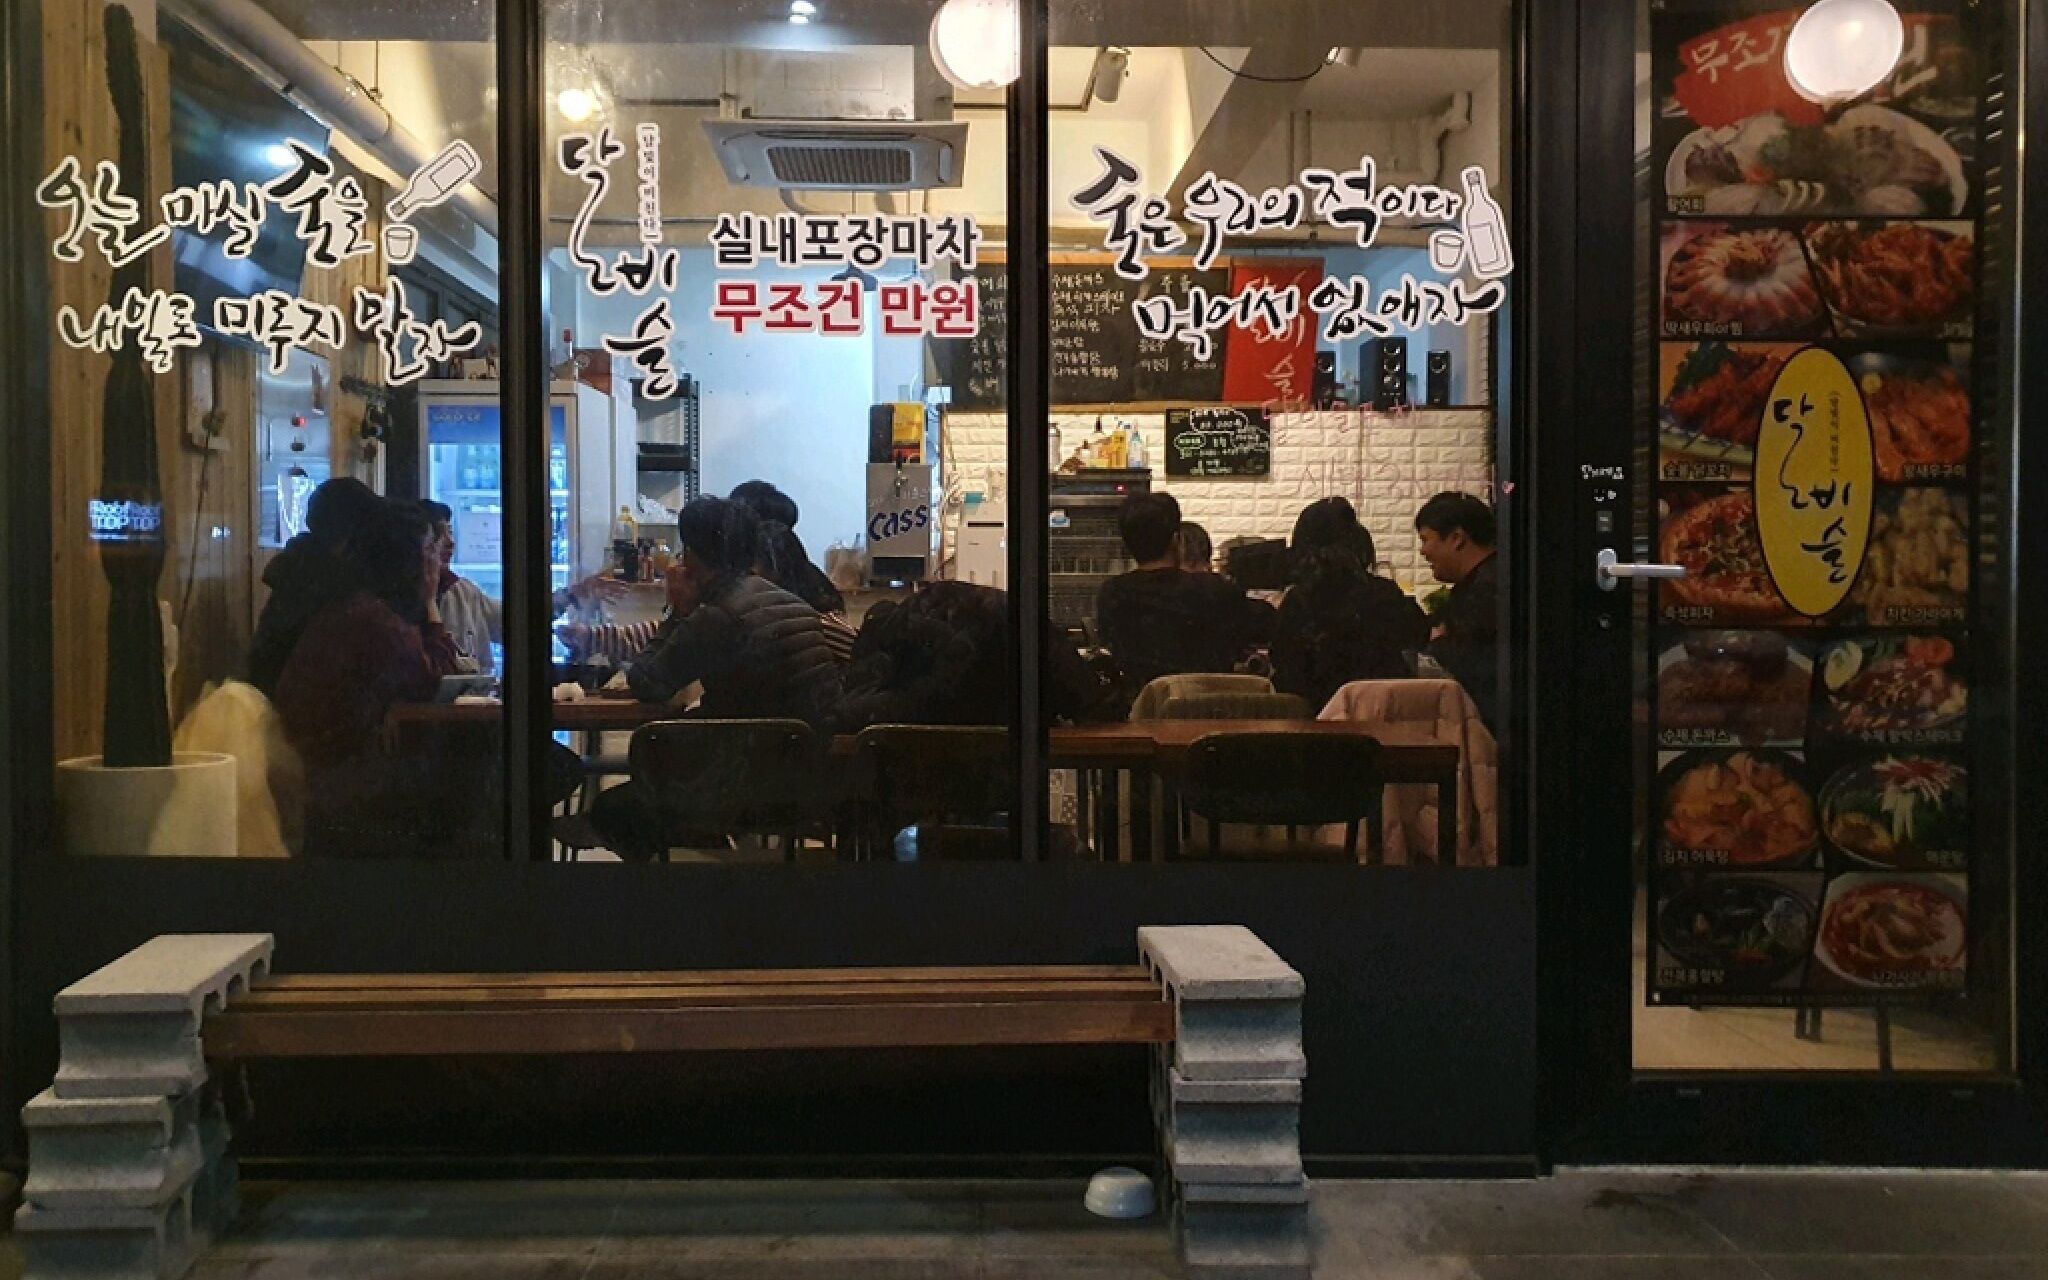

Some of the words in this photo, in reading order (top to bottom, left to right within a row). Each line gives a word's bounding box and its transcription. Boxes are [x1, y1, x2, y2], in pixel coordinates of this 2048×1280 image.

[268, 142, 373, 262] 술을
[711, 215, 977, 264] 실내포장마차
[1075, 148, 1184, 275] 술은
[1186, 176, 1300, 266] 우리의
[1303, 159, 1461, 244] 적이다
[61, 291, 199, 368] 내일로
[218, 294, 344, 369] 미루지
[357, 281, 478, 380] 말자
[714, 283, 861, 334] 무조건
[881, 283, 976, 334] 만원
[1137, 285, 1296, 355] 먹어서
[1313, 280, 1501, 337] 없애자
